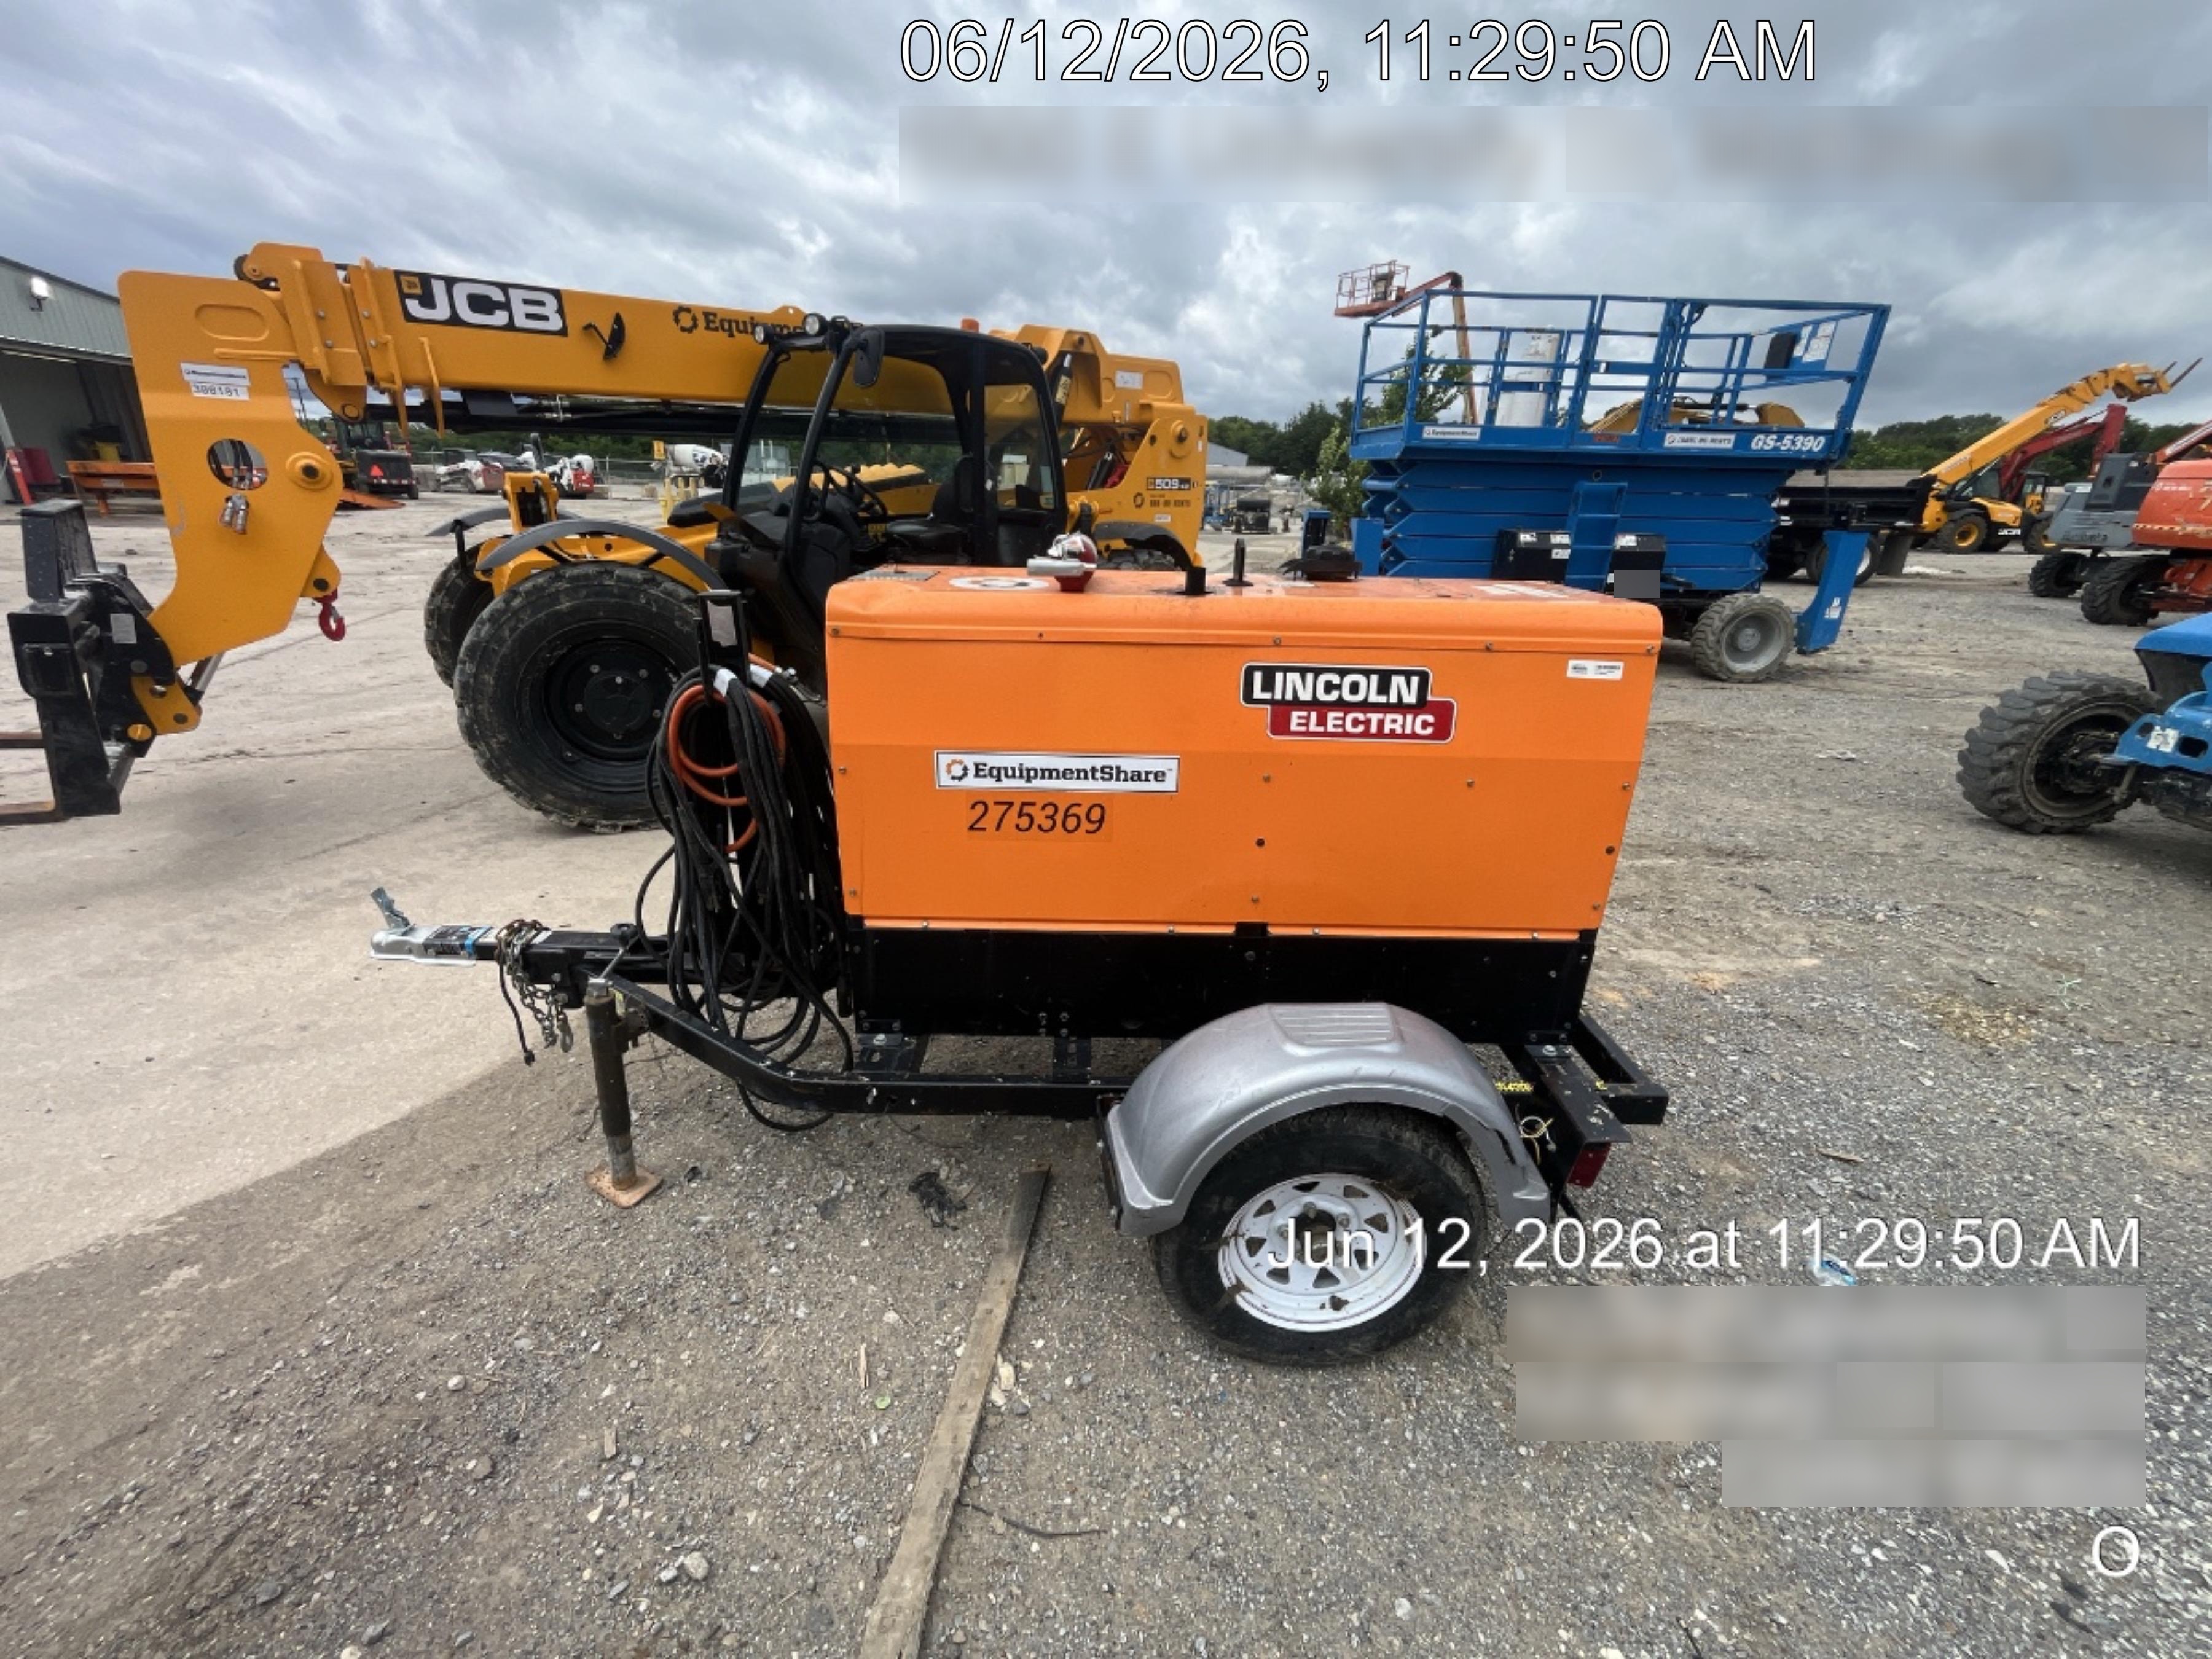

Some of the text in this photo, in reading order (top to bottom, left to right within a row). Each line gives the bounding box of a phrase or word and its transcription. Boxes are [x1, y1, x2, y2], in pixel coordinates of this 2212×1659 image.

[405, 278, 563, 331] JCB
[1751, 434, 1826, 452] GS-5390
[1252, 670, 1419, 705] LINCOLN
[1290, 710, 1435, 735] ELECTRIC
[973, 762, 1167, 783] EquipmentShare
[967, 799, 1107, 834] 275369
